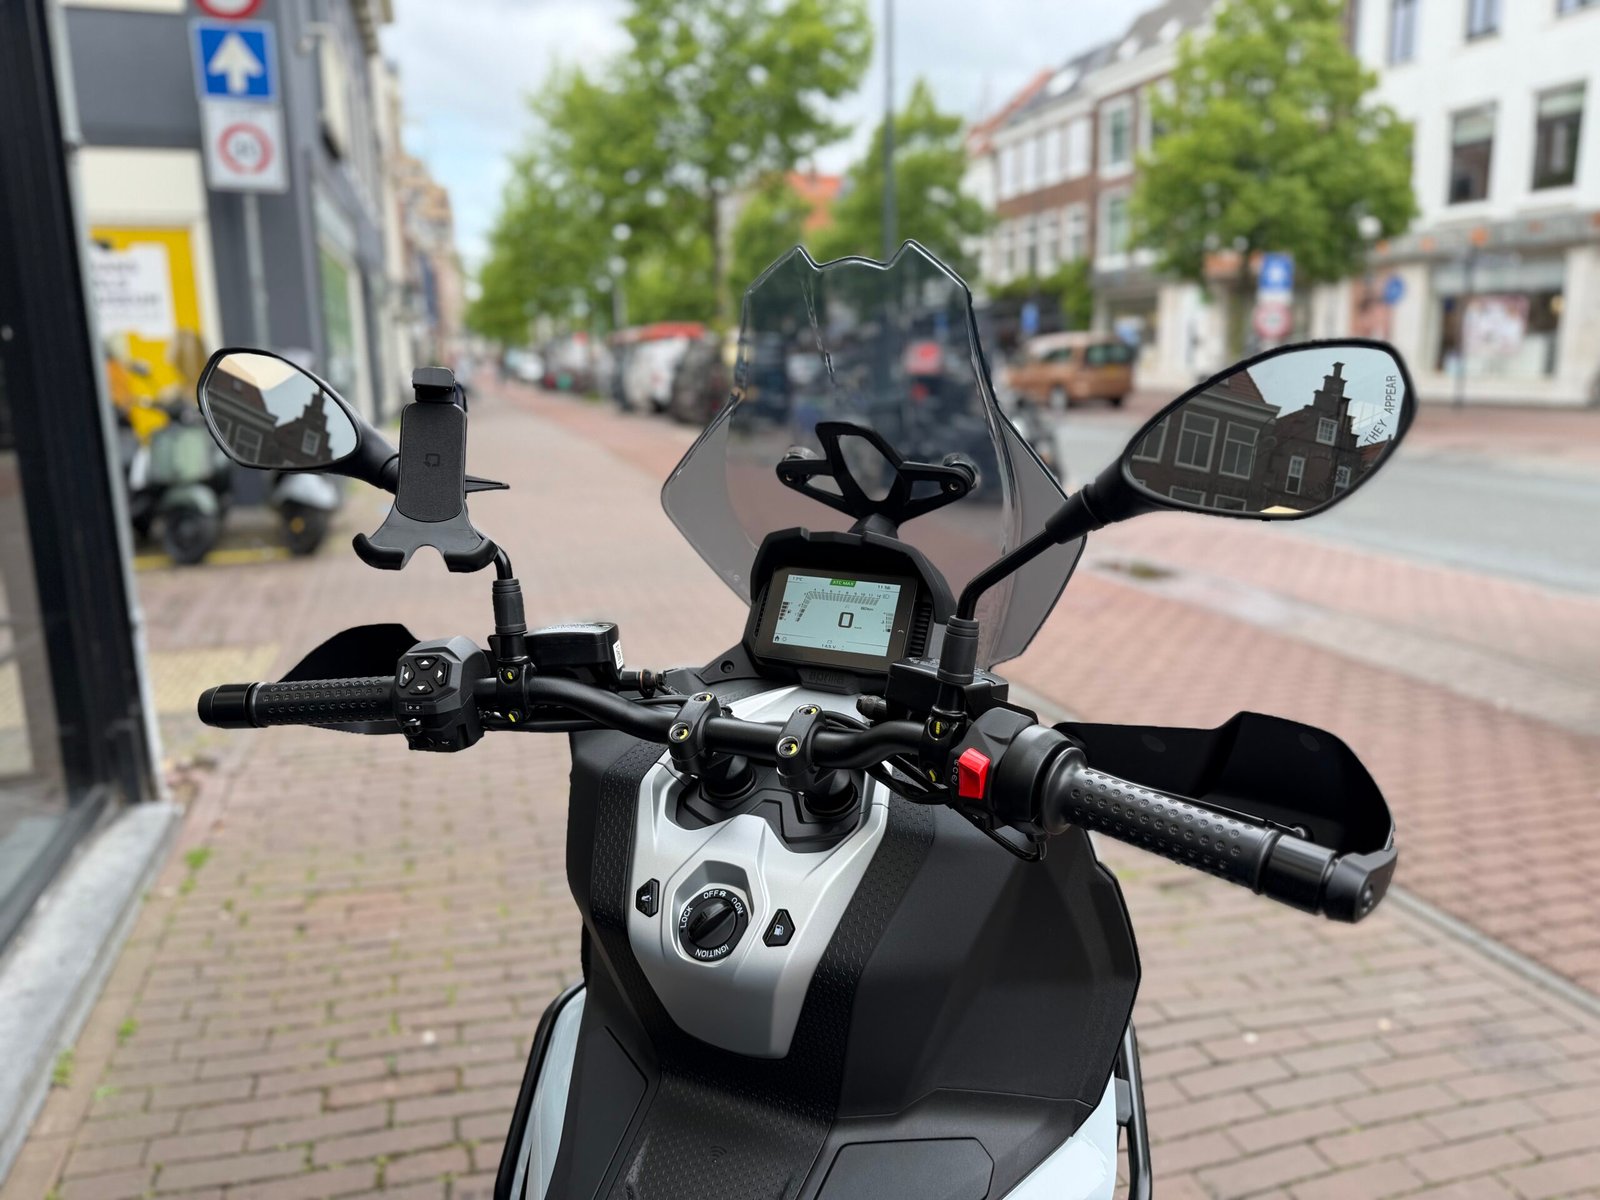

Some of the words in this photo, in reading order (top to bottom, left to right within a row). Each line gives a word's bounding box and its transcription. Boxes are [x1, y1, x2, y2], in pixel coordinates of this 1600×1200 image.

[1364, 419, 1388, 444] THEY
[1384, 375, 1397, 415] APPEAR
[838, 611, 854, 629] 0
[703, 890, 719, 899] OFF
[680, 906, 693, 928] LOCK
[695, 945, 729, 957] IGNITION
